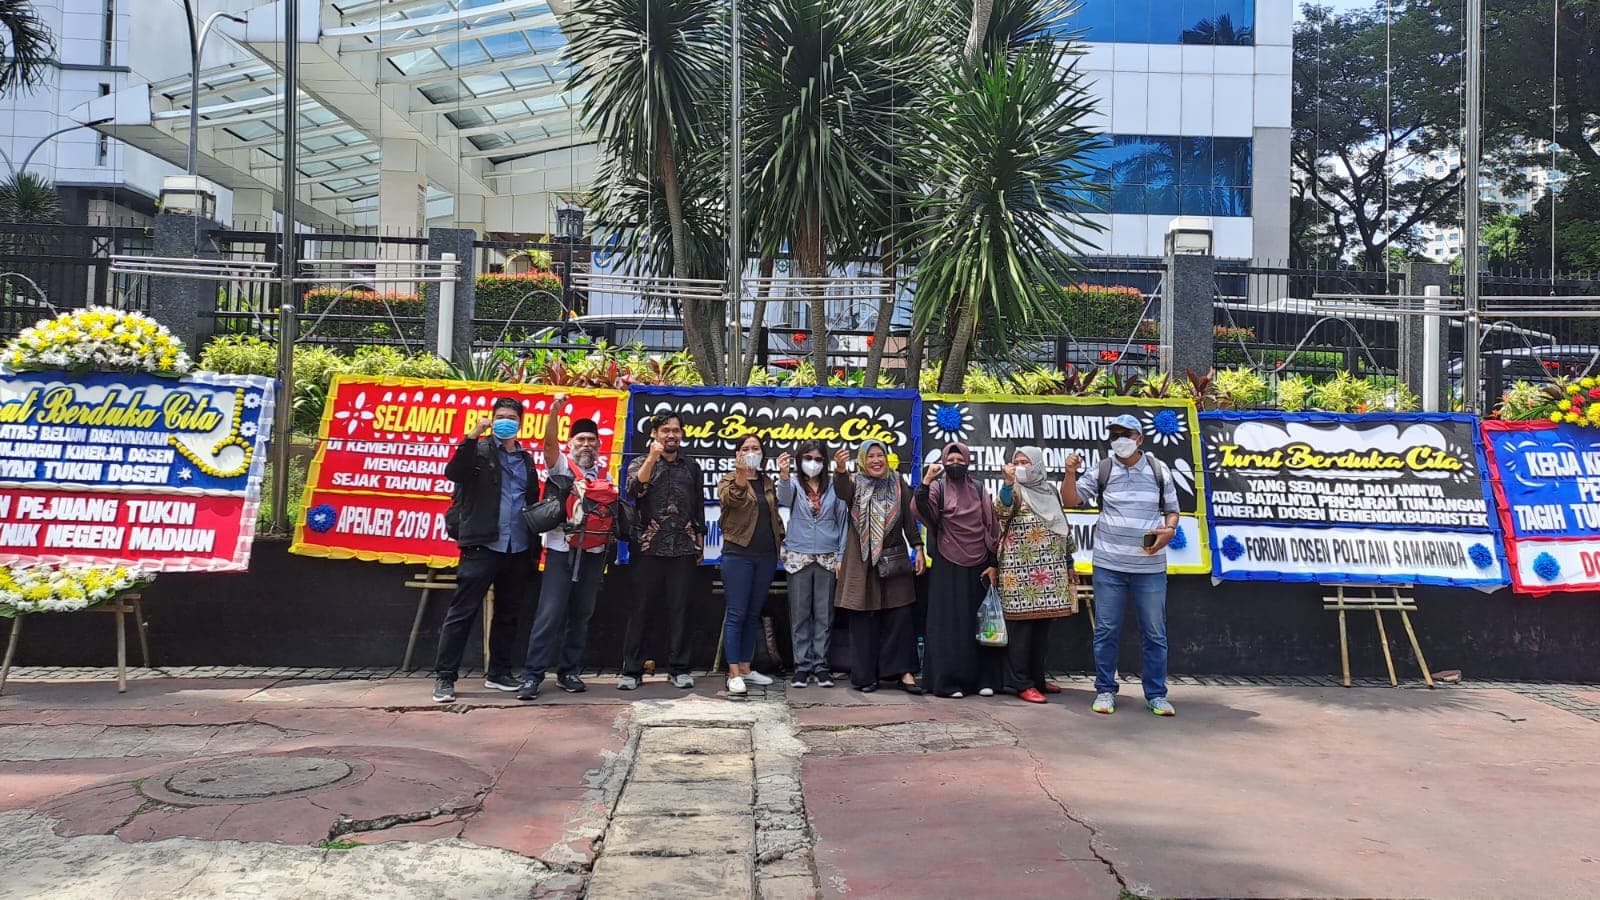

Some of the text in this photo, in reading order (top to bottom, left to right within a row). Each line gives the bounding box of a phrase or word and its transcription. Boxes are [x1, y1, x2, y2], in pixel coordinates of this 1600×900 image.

[37, 387, 161, 428] Berduka
[164, 393, 223, 431] Cita
[373, 405, 456, 434] SELAMAT
[0, 424, 38, 440] ATAS
[40, 426, 87, 443] BELUM
[718, 415, 839, 441] Berduka
[840, 417, 897, 445] Cita
[989, 413, 1114, 441] KAMI DITUNTU
[65, 445, 123, 461] KINERJA
[128, 448, 175, 464] DOSEN
[346, 441, 449, 458] KEMENTERIAN
[968, 446, 1006, 472] ETAK
[1219, 445, 1463, 471] Turut Berduka Cita
[0, 460, 169, 483] YAR TUKIN DOSEN
[1524, 452, 1583, 477] KERJA
[332, 472, 381, 488] SEJAK
[384, 475, 432, 491] TAHUN
[1248, 479, 1445, 498] YANG SEDALAM-DALAMNYA
[16, 496, 119, 523] PEJUANG
[126, 500, 197, 526] TUKIN
[1211, 491, 1487, 512] ATAS BATALNYA PENCAIRAN TUNJANGAN
[336, 505, 394, 537] APENJER
[394, 510, 431, 540] 2019
[1213, 504, 1488, 526] KINERJA DOSEN KEMENDIKBUDRISTEK
[1513, 504, 1567, 531] TAGIH
[0, 523, 216, 553] NIK NEGERI MADIUN
[1245, 537, 1468, 569] FORUM DOSEN POLITANI SAMARINDA
